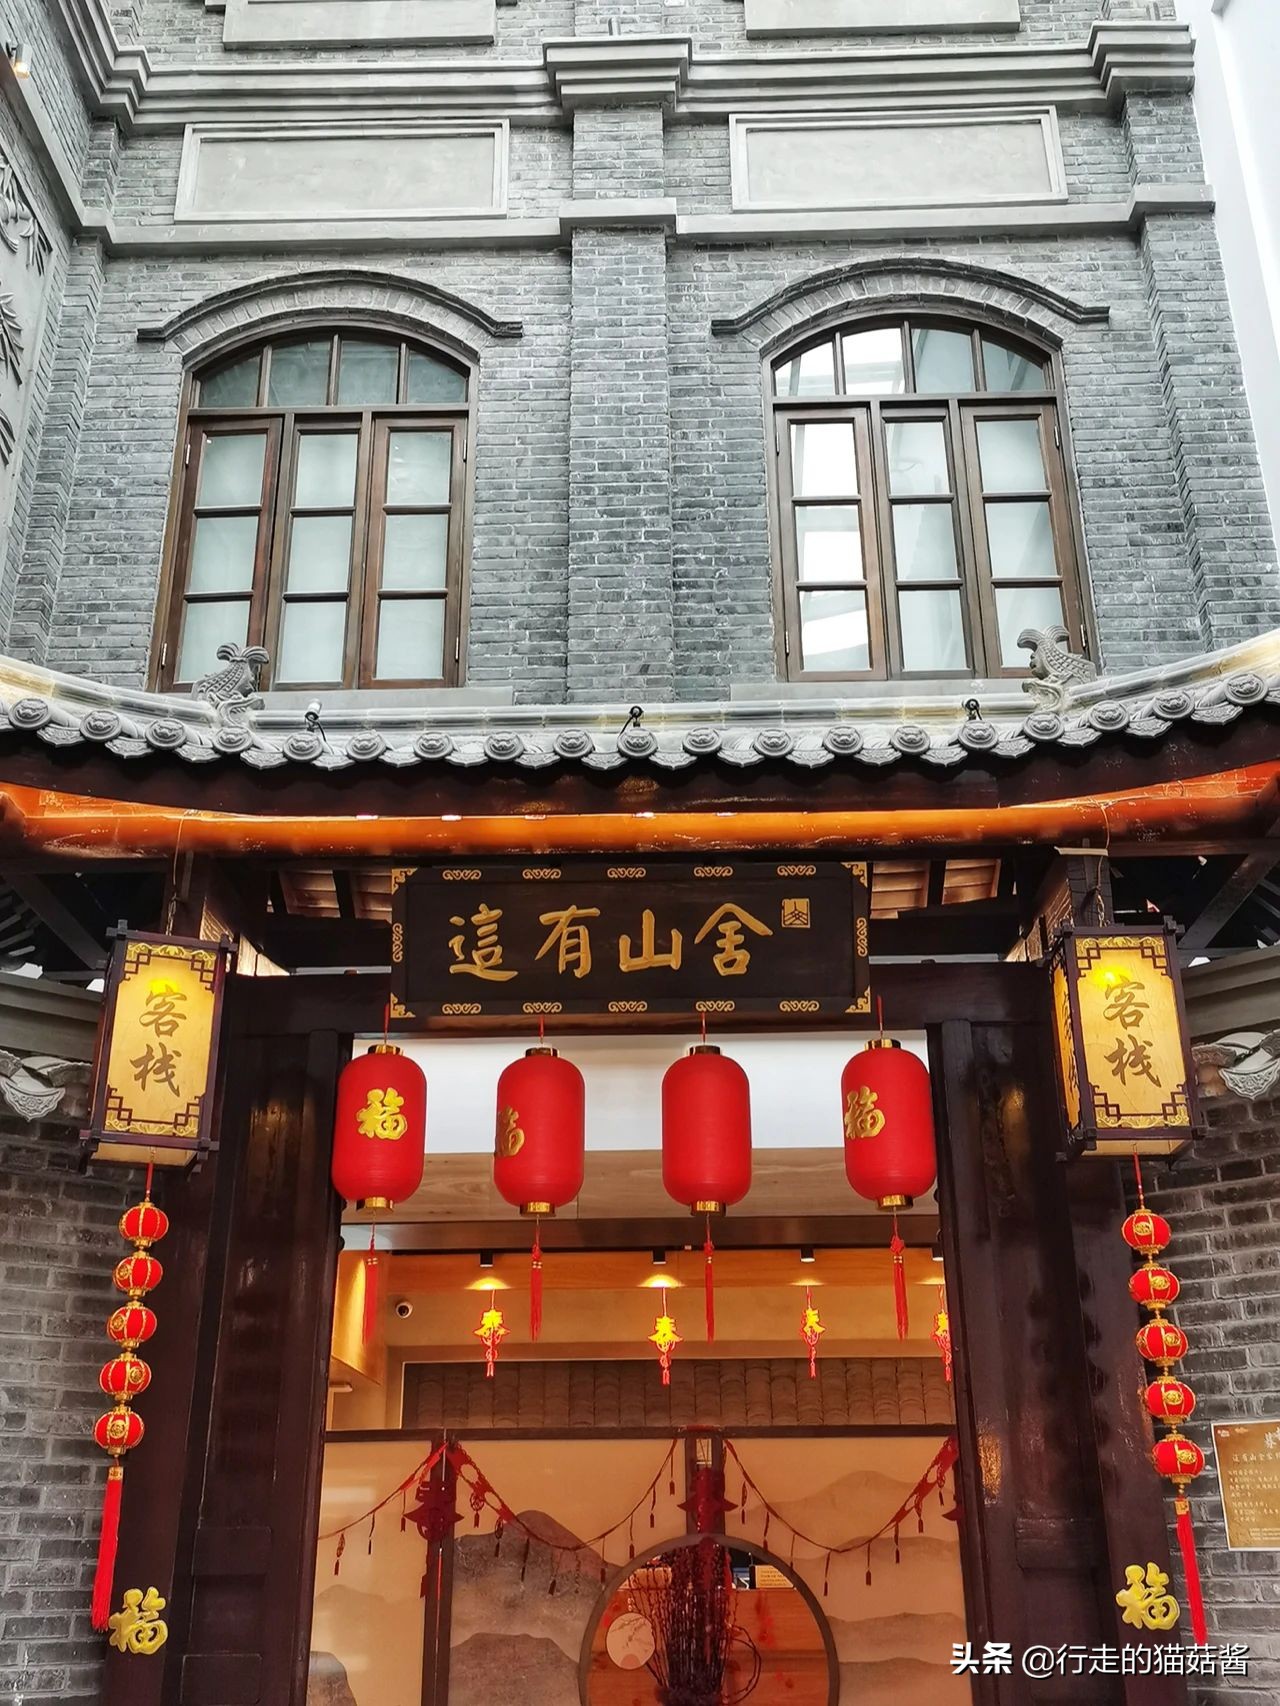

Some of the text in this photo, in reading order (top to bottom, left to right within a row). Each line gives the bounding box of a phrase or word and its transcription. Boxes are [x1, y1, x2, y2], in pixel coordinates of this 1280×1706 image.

[448, 902, 774, 981] 這有山舍
[129, 984, 188, 1098] 客栈
[1102, 974, 1162, 1089] 客栈
[357, 1087, 408, 1140] 福
[844, 1085, 886, 1139] 福
[108, 1586, 169, 1656] 福
[1115, 1561, 1181, 1631] 福
